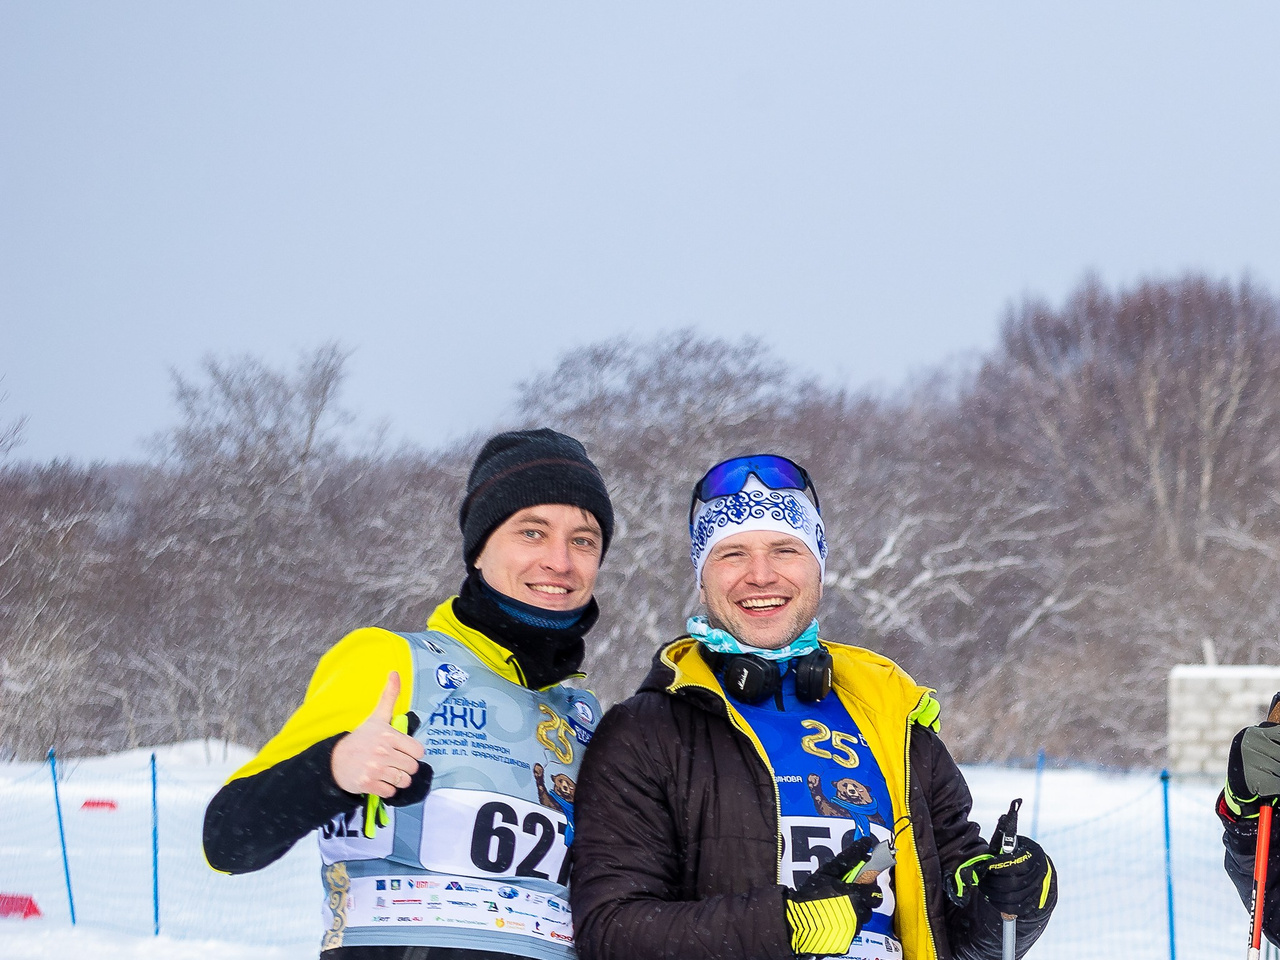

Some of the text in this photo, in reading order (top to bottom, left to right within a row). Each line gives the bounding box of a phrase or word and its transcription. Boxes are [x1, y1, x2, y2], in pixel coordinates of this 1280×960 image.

[536, 703, 573, 765] 25
[800, 719, 860, 769] 25
[988, 854, 1029, 871] FISCHER
